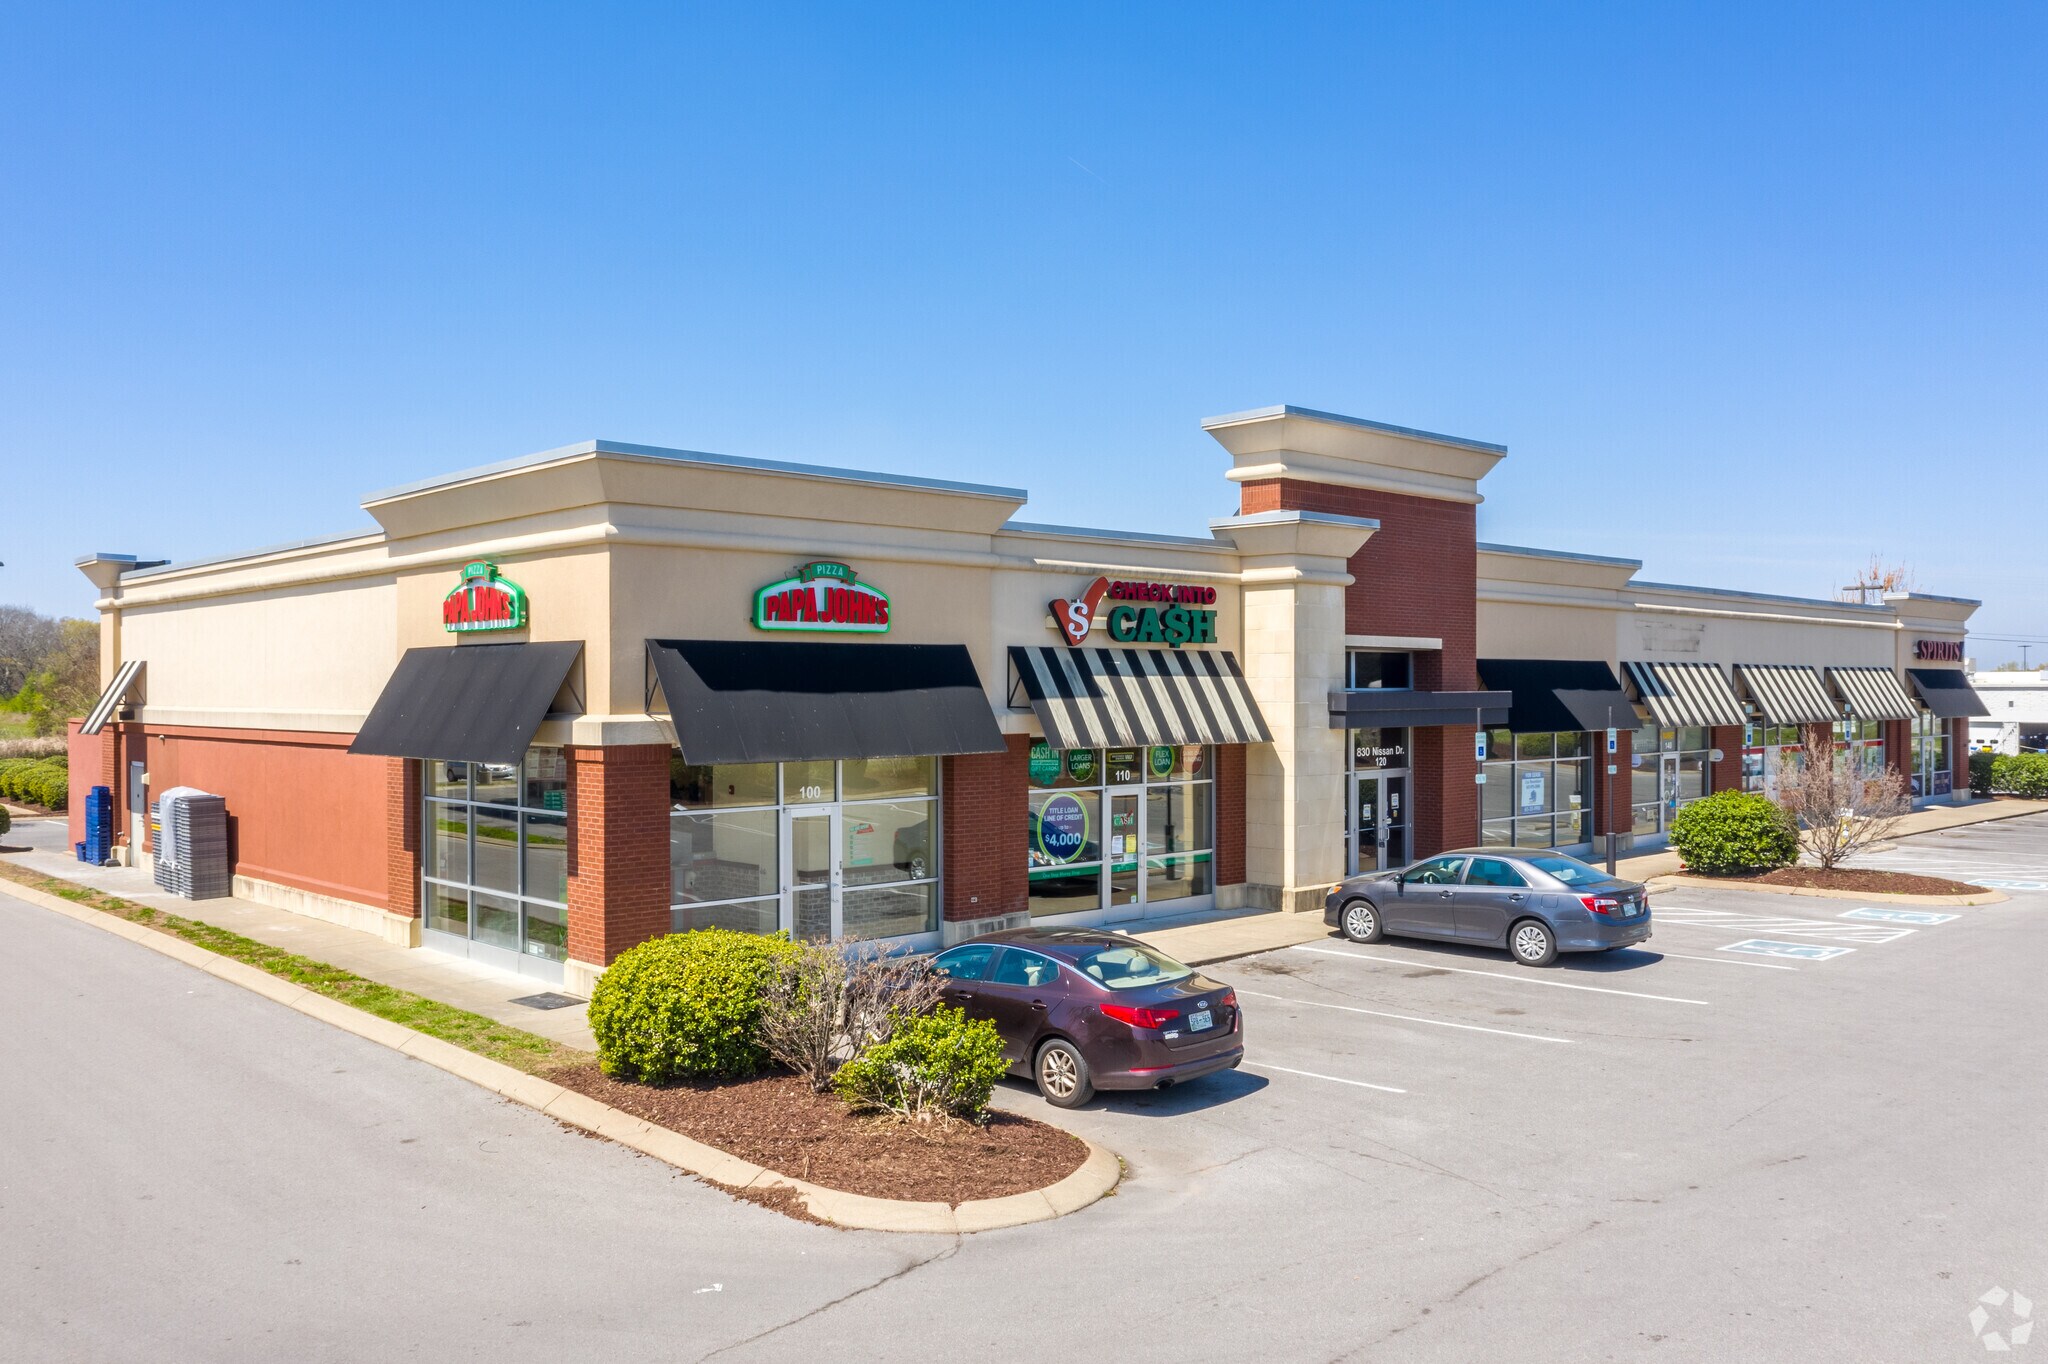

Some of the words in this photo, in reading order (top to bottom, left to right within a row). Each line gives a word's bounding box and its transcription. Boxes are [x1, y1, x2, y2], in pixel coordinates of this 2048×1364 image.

[468, 564, 483, 576] PIZZA
[817, 565, 844, 576] PIZZA
[1110, 581, 1174, 603] CHECK
[1177, 586, 1217, 604] INTO
[443, 588, 471, 624] PAPA
[765, 587, 819, 623] PAPA
[821, 586, 889, 625] JOHN'S
[1108, 604, 1218, 648] CA$H
[1919, 640, 1961, 661] SPIRITS
[1031, 747, 1050, 759] CASH
[1051, 749, 1059, 759] IN
[1155, 750, 1169, 758] FLEX
[1356, 747, 1370, 757] 830
[1372, 746, 1393, 756] Nissan
[1396, 745, 1405, 755] Dr.
[1070, 754, 1092, 762] LARGER
[1154, 758, 1171, 766] LOAN
[1375, 757, 1387, 766] 120
[1115, 770, 1131, 781] 110
[799, 786, 821, 799] 100
[1045, 833, 1081, 847] $4,000
